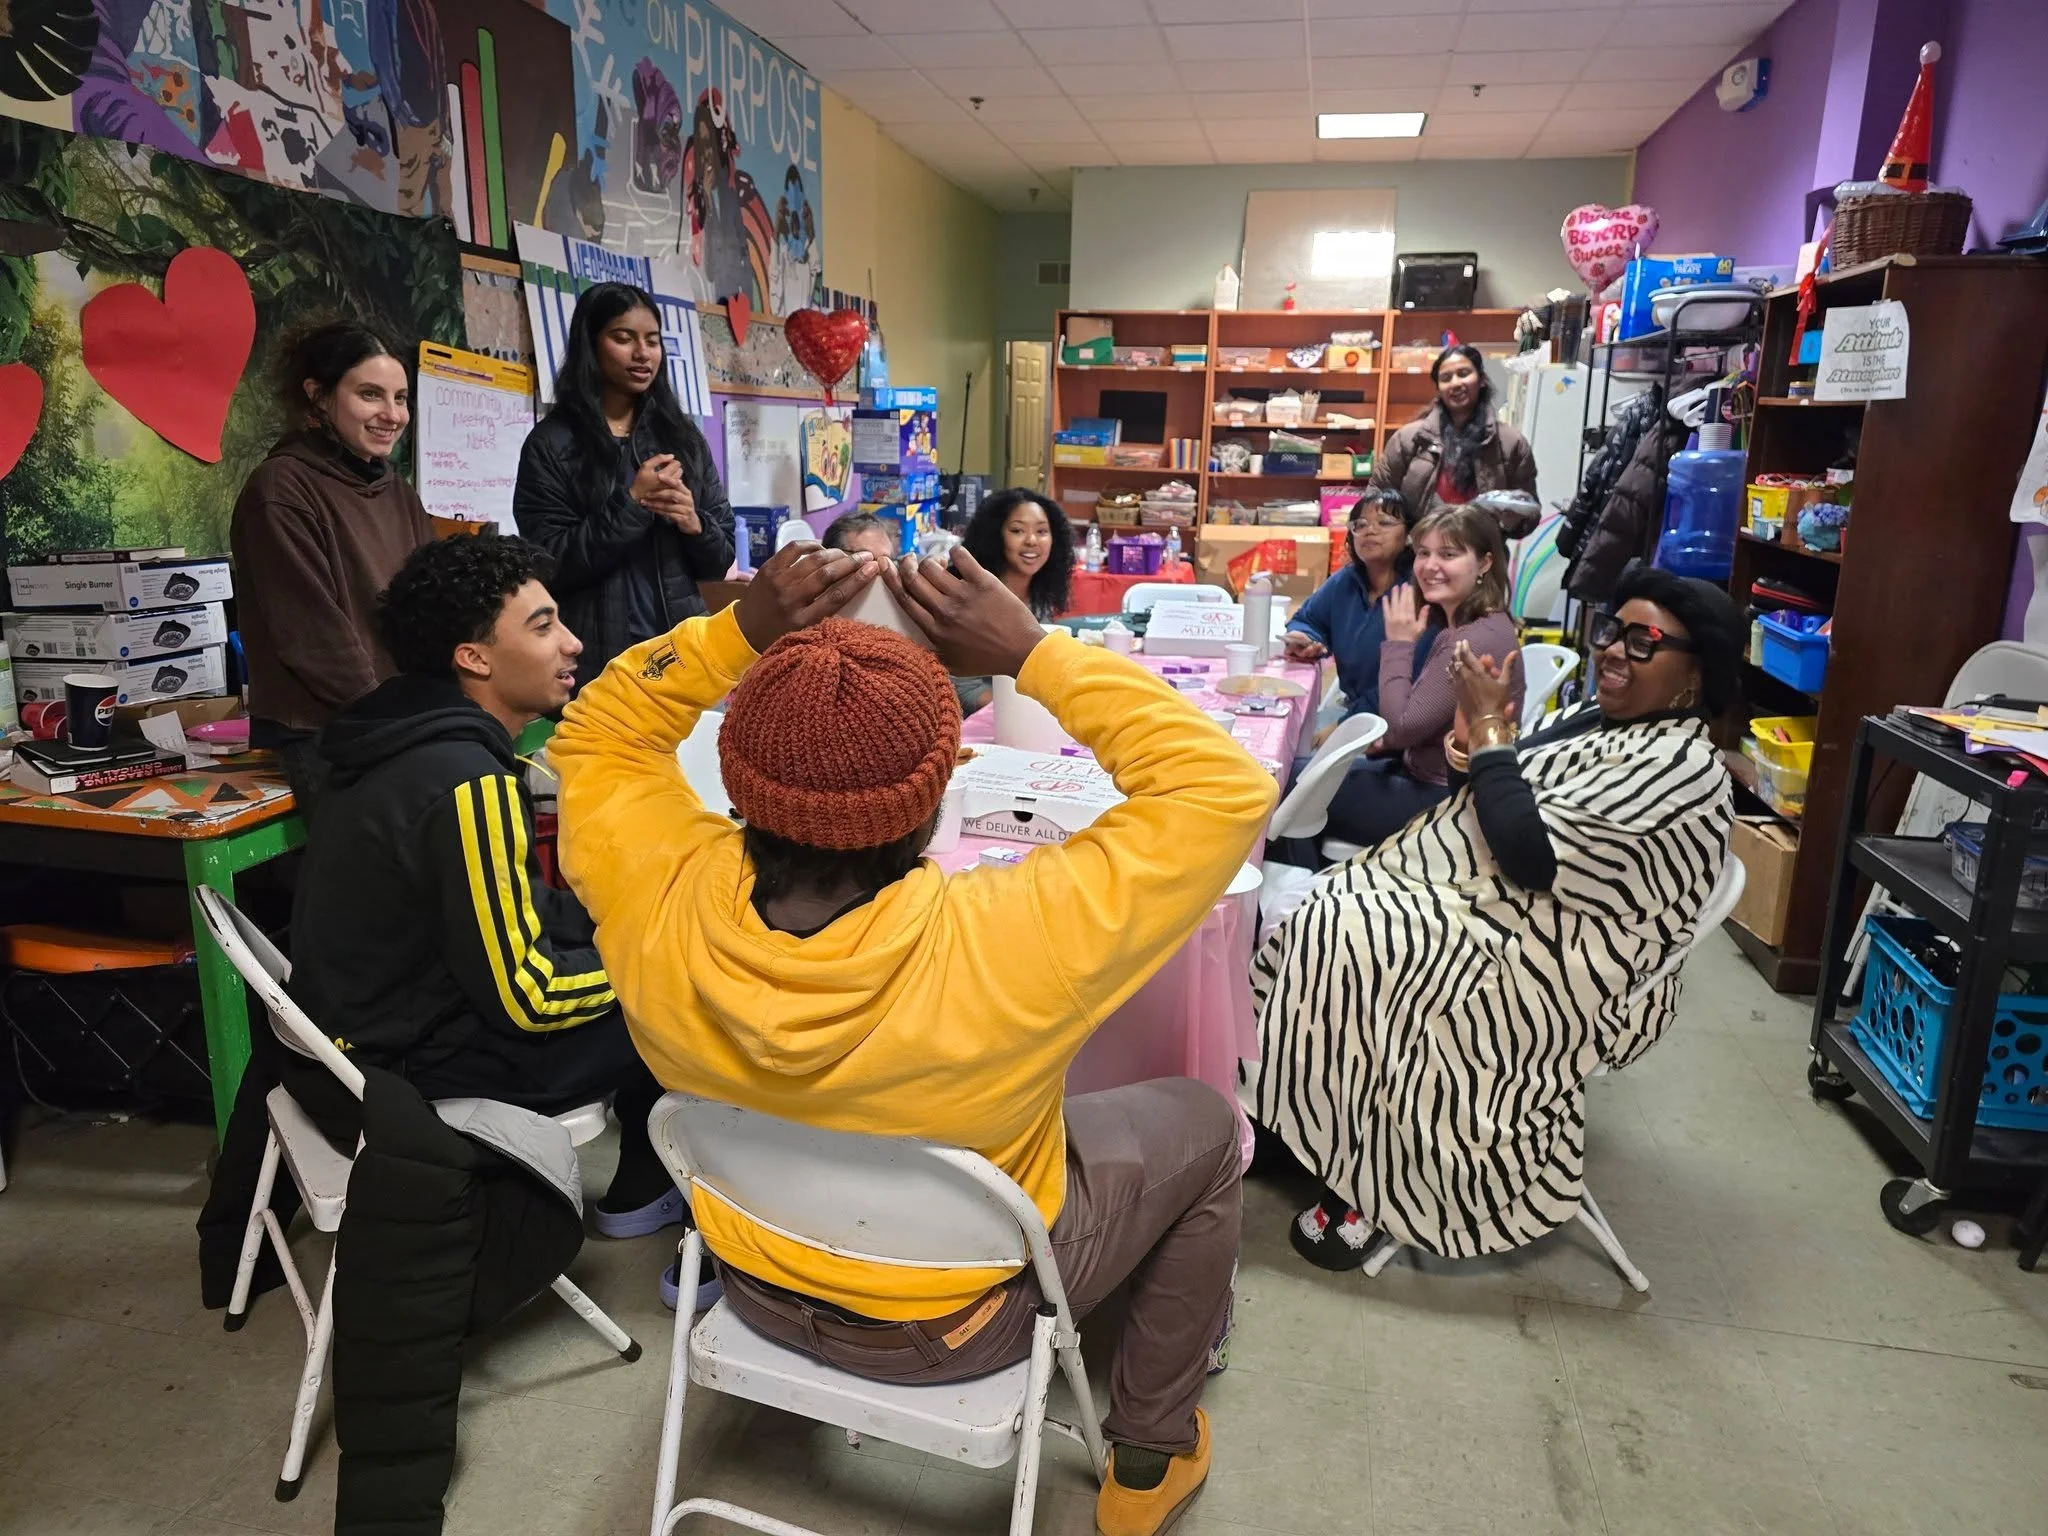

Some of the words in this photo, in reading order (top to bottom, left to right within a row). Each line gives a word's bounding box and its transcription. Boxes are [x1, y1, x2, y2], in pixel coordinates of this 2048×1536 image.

[647, 0, 678, 54] ON
[684, 3, 817, 173] PURPOSE
[1869, 317, 1891, 329] YOUR
[1834, 327, 1904, 353] Attitude
[64, 581, 88, 591] Single
[89, 581, 113, 589] Burner
[963, 818, 982, 830] WE
[986, 821, 1030, 837] DELIVER
[1035, 828, 1056, 841] ALL
